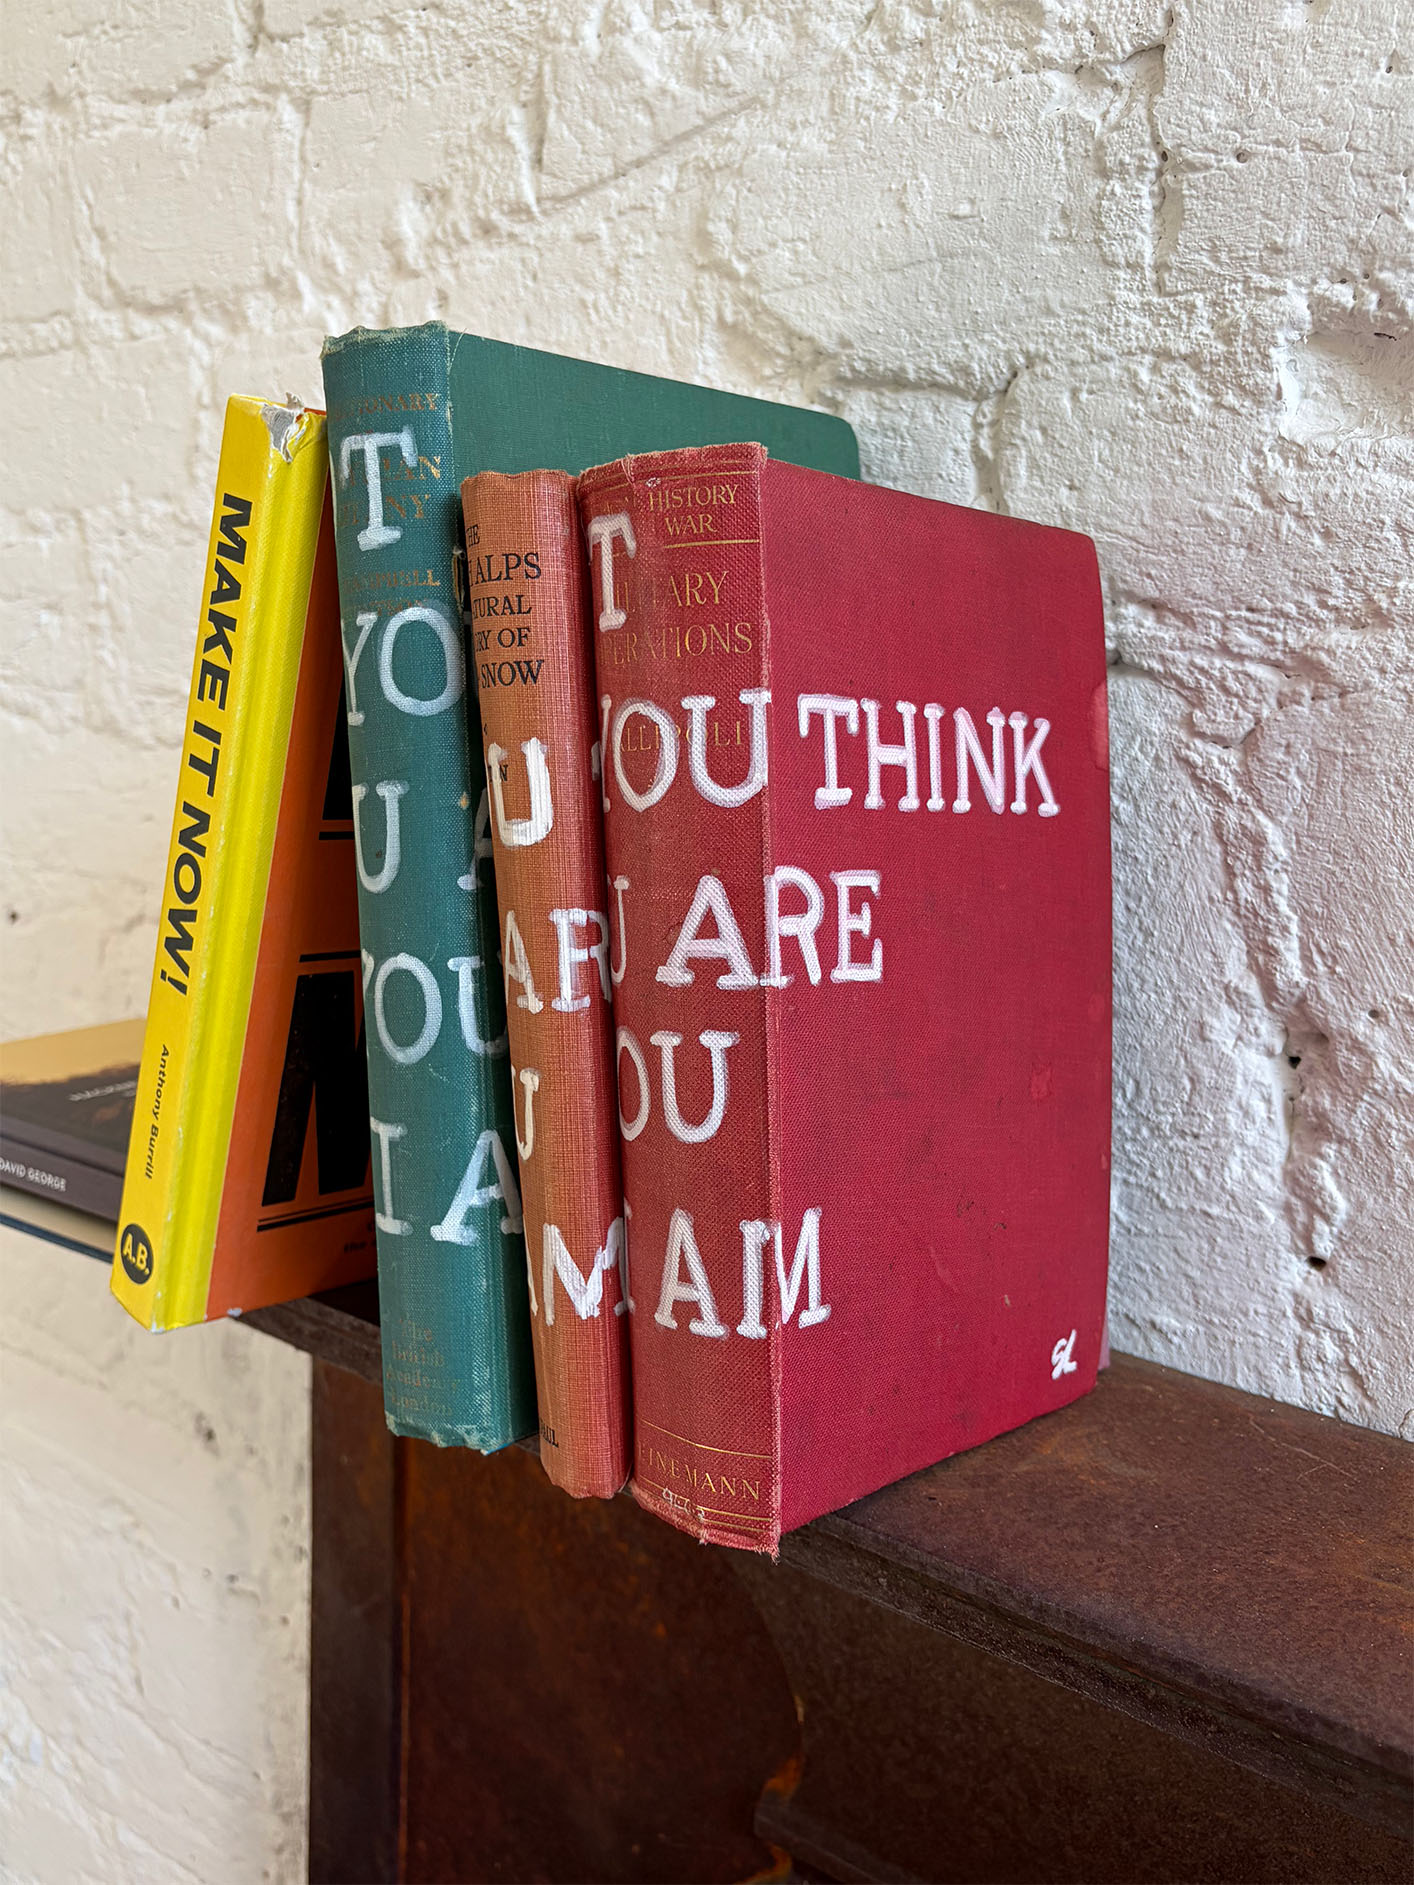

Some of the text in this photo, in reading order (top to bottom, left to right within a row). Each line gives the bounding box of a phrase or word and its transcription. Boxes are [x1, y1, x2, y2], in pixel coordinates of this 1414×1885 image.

[339, 426, 418, 551] T
[647, 484, 739, 512] HISTORY
[664, 513, 718, 537] WAR
[475, 552, 542, 585] ALPS
[588, 511, 637, 632] T
[481, 659, 545, 689] SNOW
[497, 627, 532, 649] OF
[160, 493, 253, 995] MAKE IT NOW!
[797, 693, 1062, 818] THINK
[655, 865, 884, 990] ARE
[145, 1044, 170, 1180] Anthony Burrill
[123, 1232, 150, 1275] A.B.
[654, 1206, 832, 1340] AM
